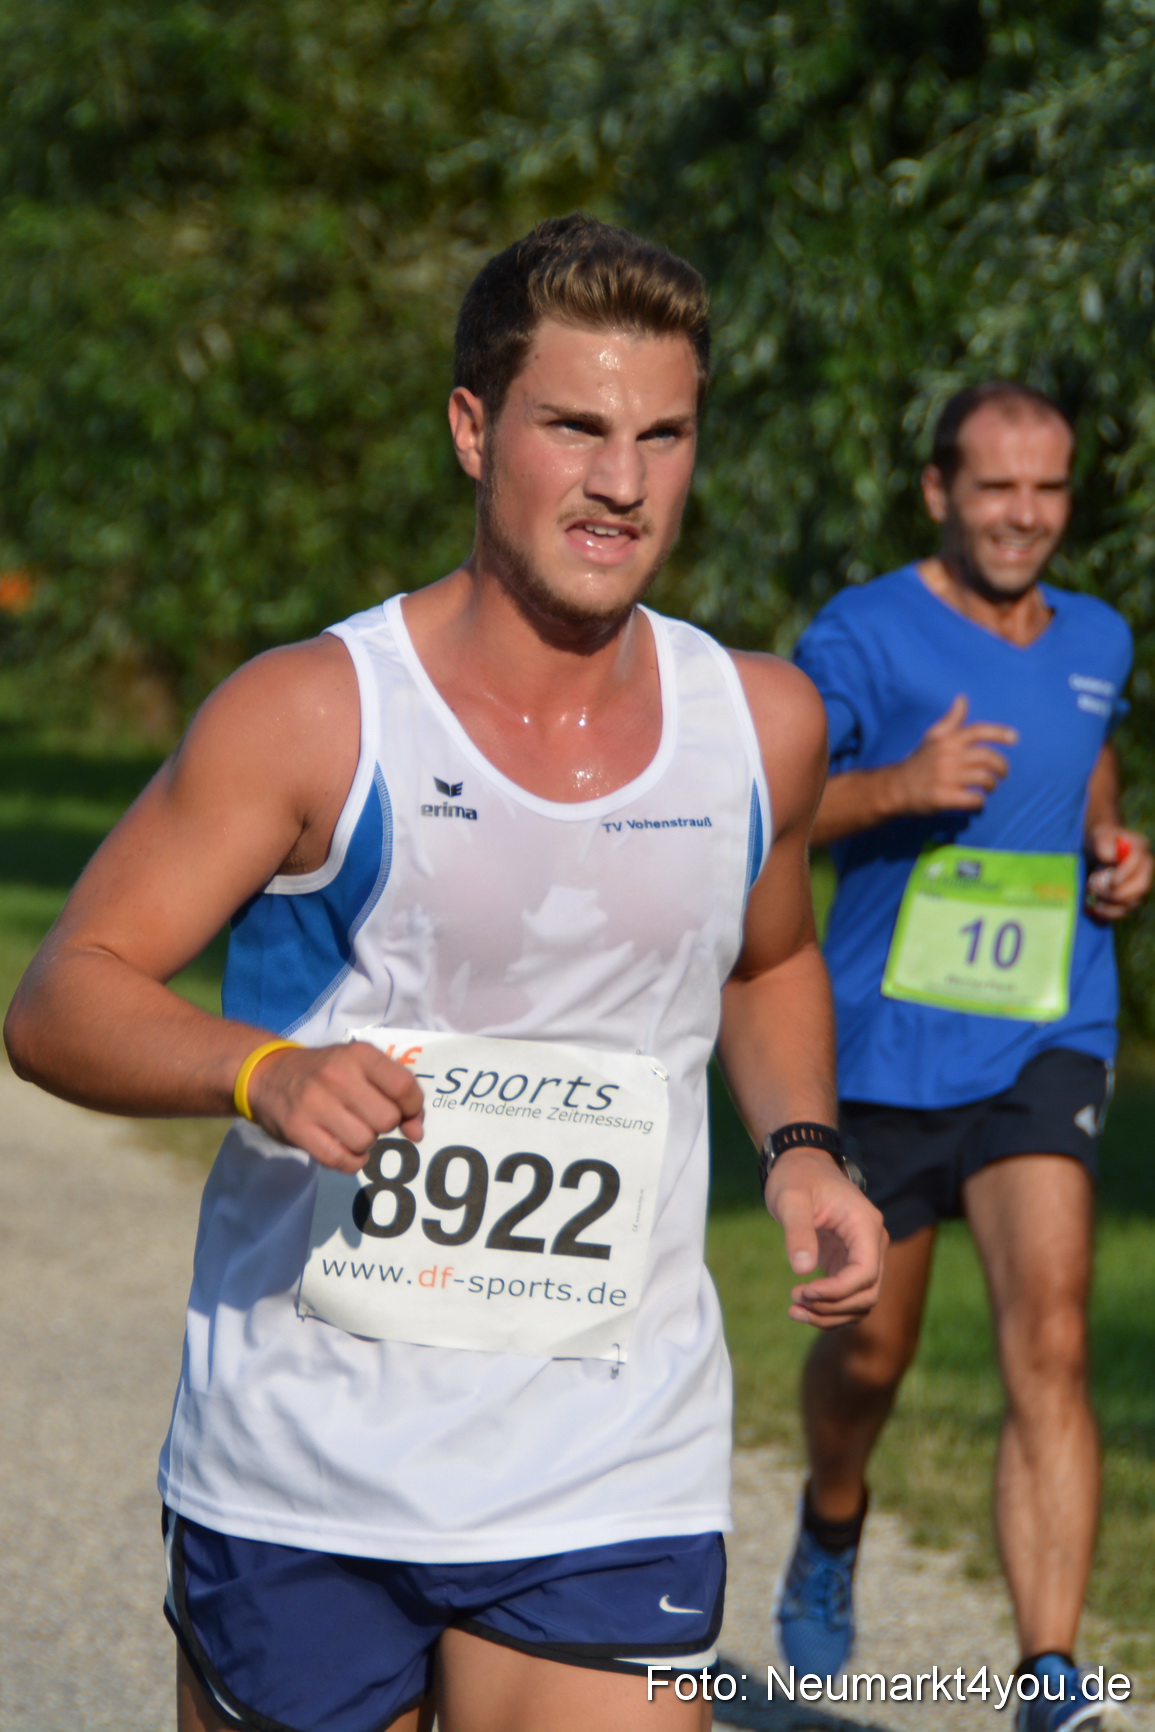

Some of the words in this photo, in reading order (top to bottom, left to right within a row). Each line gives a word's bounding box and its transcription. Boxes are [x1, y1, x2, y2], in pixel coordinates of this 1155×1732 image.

[420, 802, 478, 820] erima
[602, 821, 622, 833] TV
[626, 817, 712, 831] Vohenstrauß
[960, 916, 1024, 970] 10
[385, 1044, 620, 1111] f-sports
[432, 1094, 457, 1110] die
[468, 1100, 542, 1120] moderne
[547, 1106, 654, 1135] Zeitmessung
[352, 1137, 621, 1260] 8922
[322, 1258, 627, 1306] www.df-sports.de
